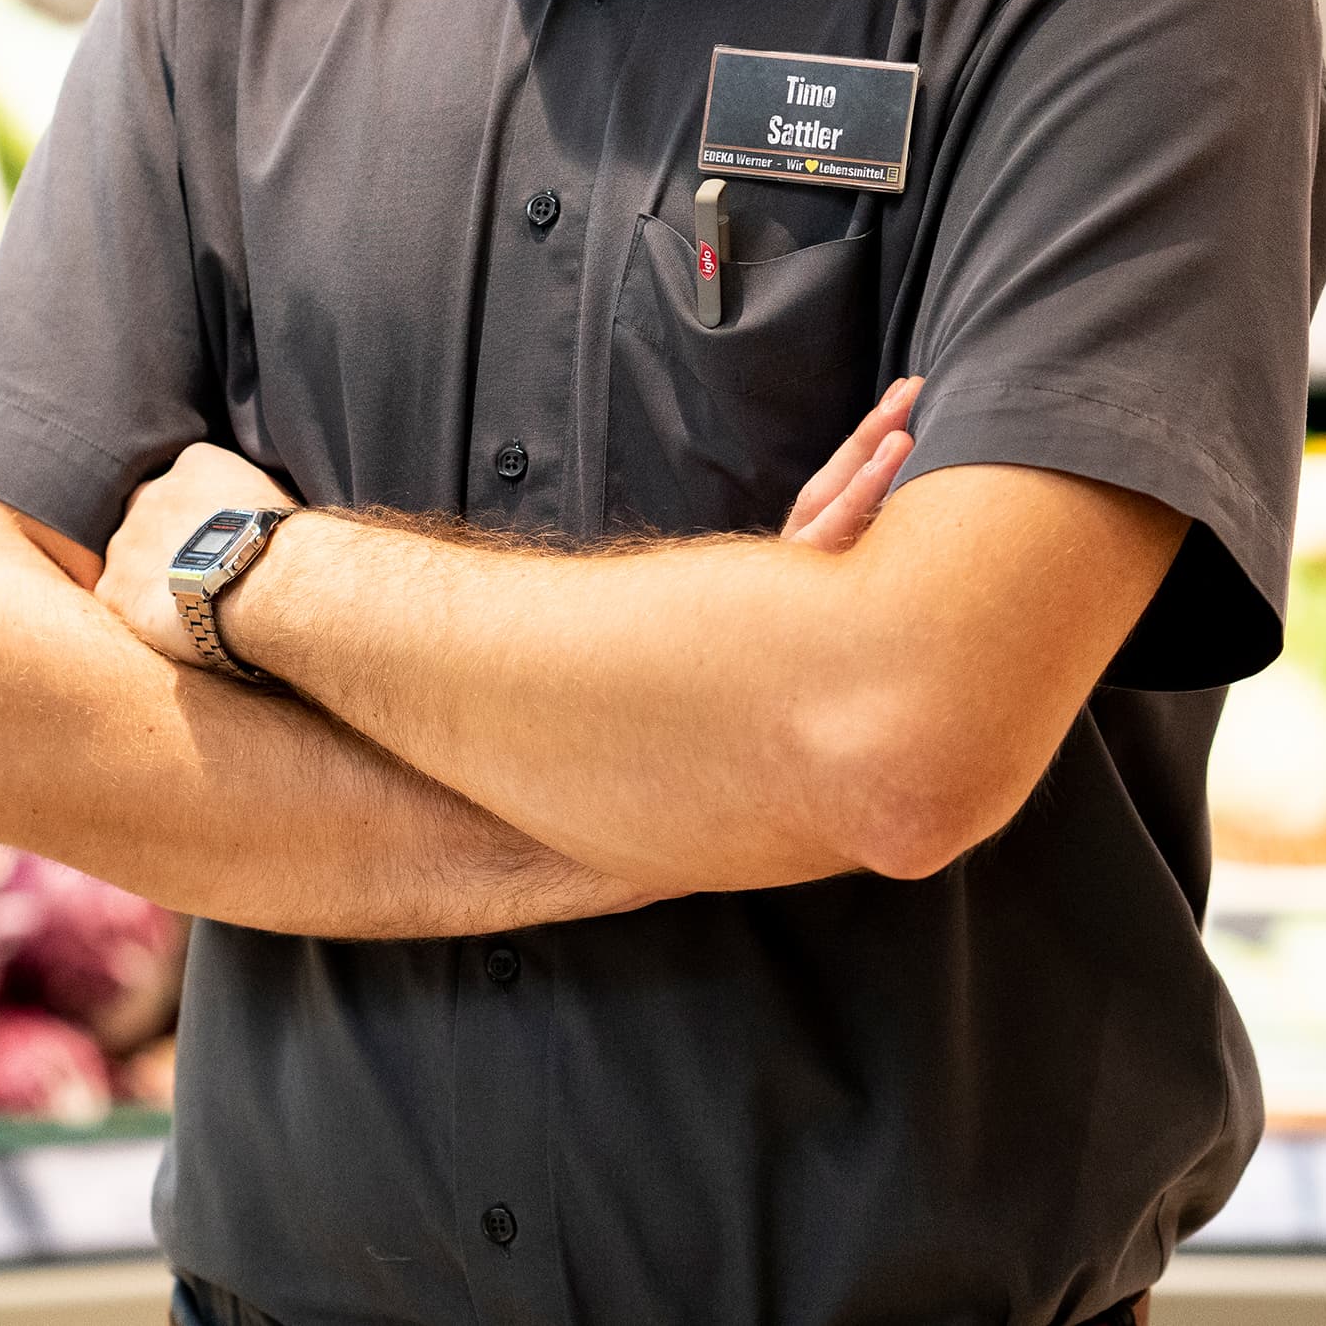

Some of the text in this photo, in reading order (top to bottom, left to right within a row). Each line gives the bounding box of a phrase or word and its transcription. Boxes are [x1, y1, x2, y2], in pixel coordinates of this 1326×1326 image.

[786, 75, 837, 108] Timo
[767, 115, 844, 151] Sattler
[703, 150, 734, 164] EDEKA
[736, 153, 773, 168] Werner
[786, 158, 804, 171] Wir
[701, 250, 715, 274] iglo
